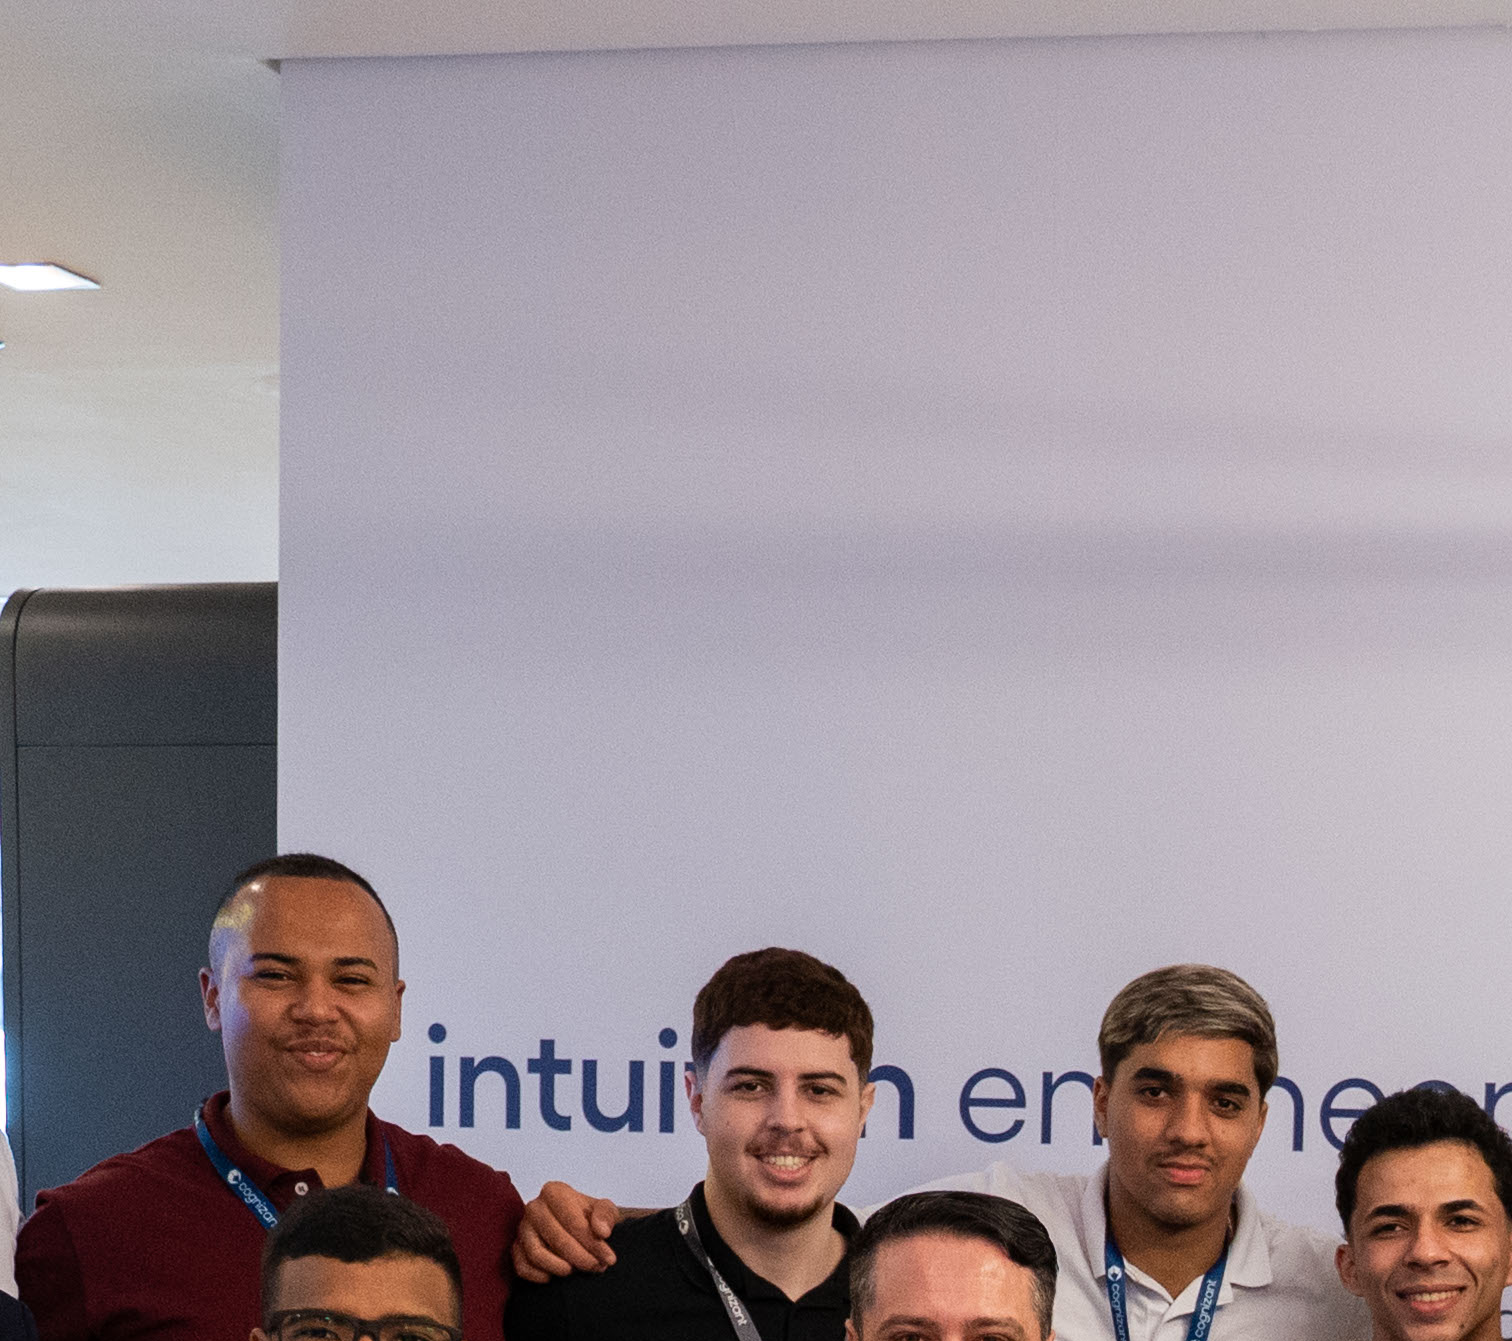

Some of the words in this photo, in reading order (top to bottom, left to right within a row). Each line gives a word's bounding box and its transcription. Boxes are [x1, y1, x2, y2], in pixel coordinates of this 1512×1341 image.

[427, 1022, 915, 1141] intuin
[238, 1182, 279, 1228] cognizan
[1195, 1279, 1218, 1338] cognizant
